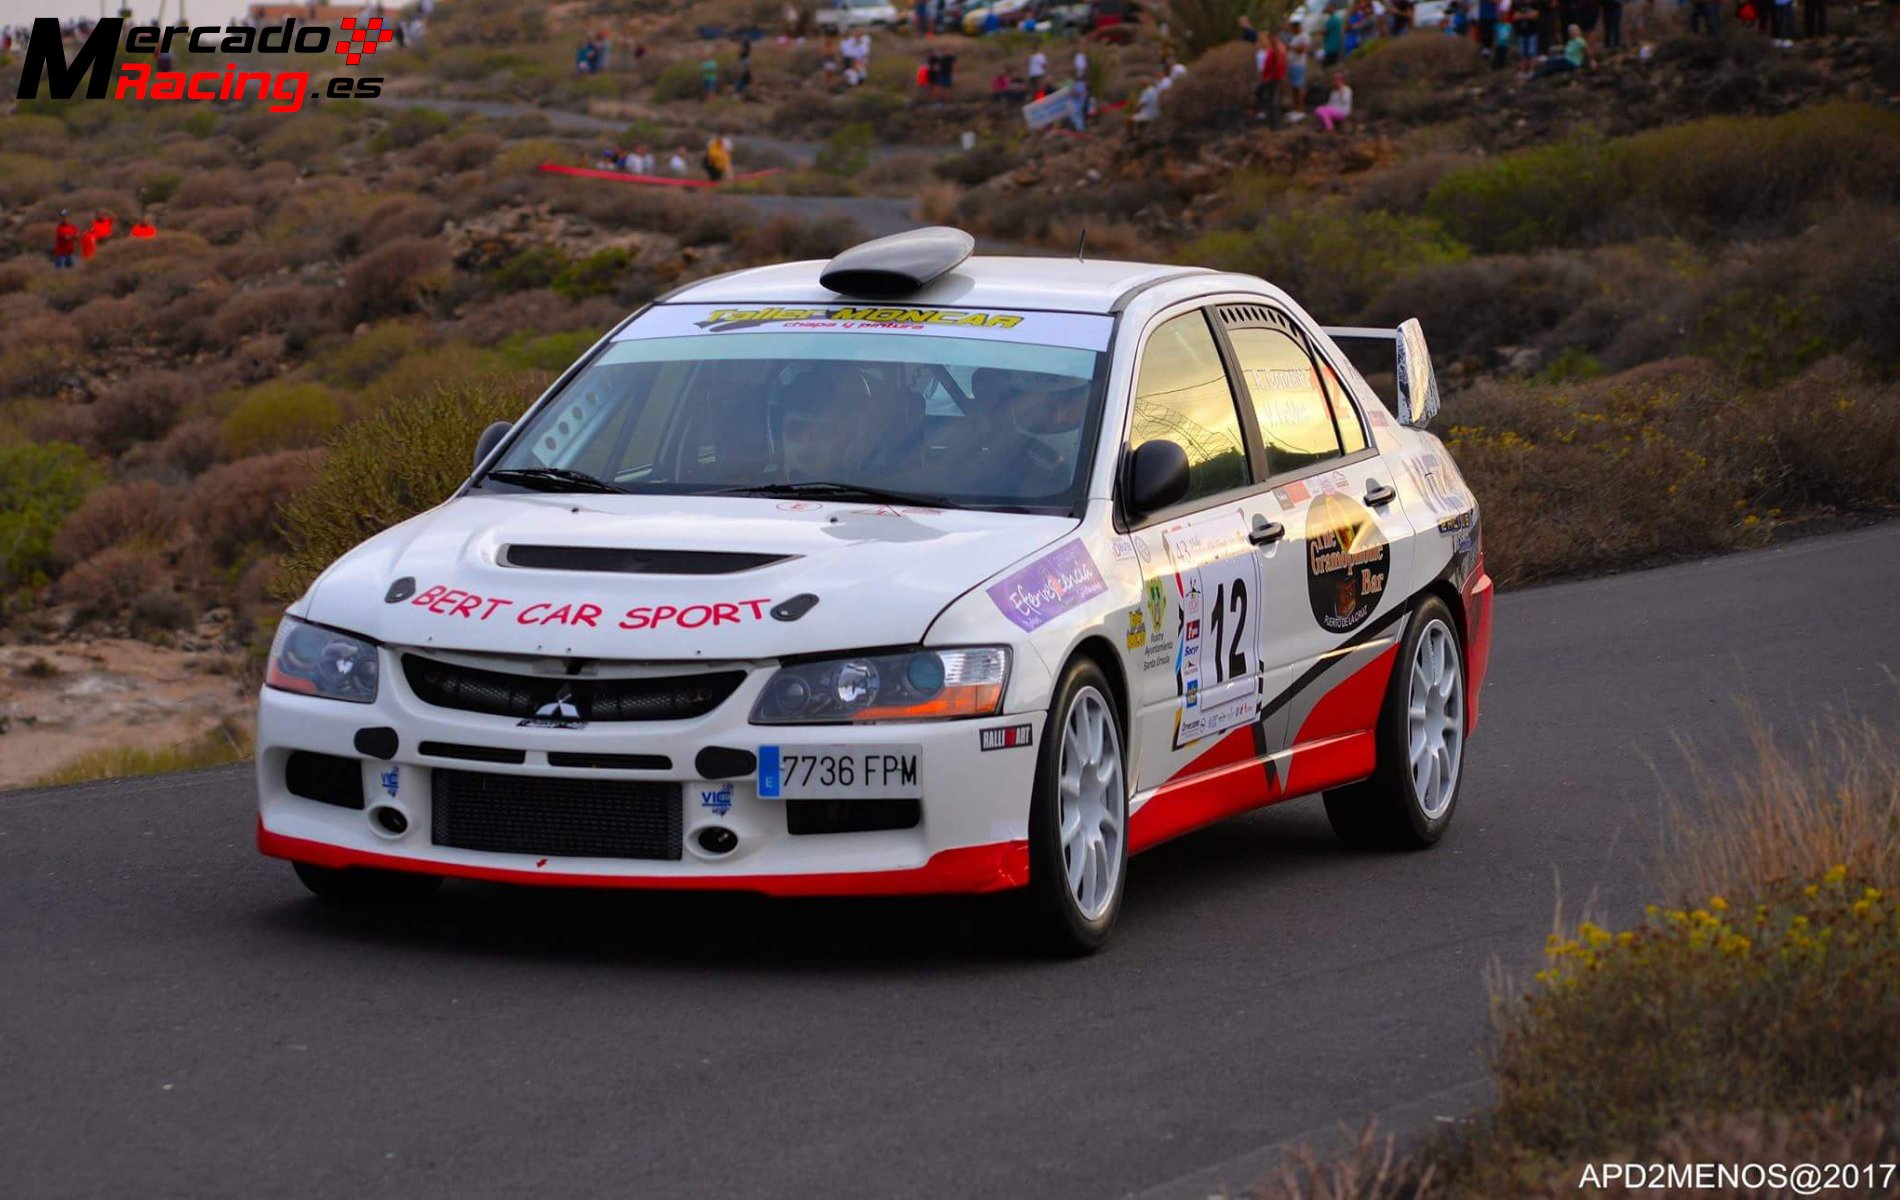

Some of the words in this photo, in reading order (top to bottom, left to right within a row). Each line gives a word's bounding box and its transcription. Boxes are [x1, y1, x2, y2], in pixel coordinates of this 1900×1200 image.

[830, 307, 1024, 329] MONCAR
[858, 321, 924, 330] pintura
[1361, 568, 1384, 596] Bar
[411, 585, 513, 620] BERT
[517, 603, 602, 627] CAR
[619, 599, 772, 630] SPORT
[1323, 615, 1341, 628] PUERTO
[1354, 605, 1368, 621] CRUZ
[1211, 577, 1248, 684] 12
[765, 776, 773, 788] E
[783, 755, 854, 787] 7736
[864, 755, 917, 787] FPM
